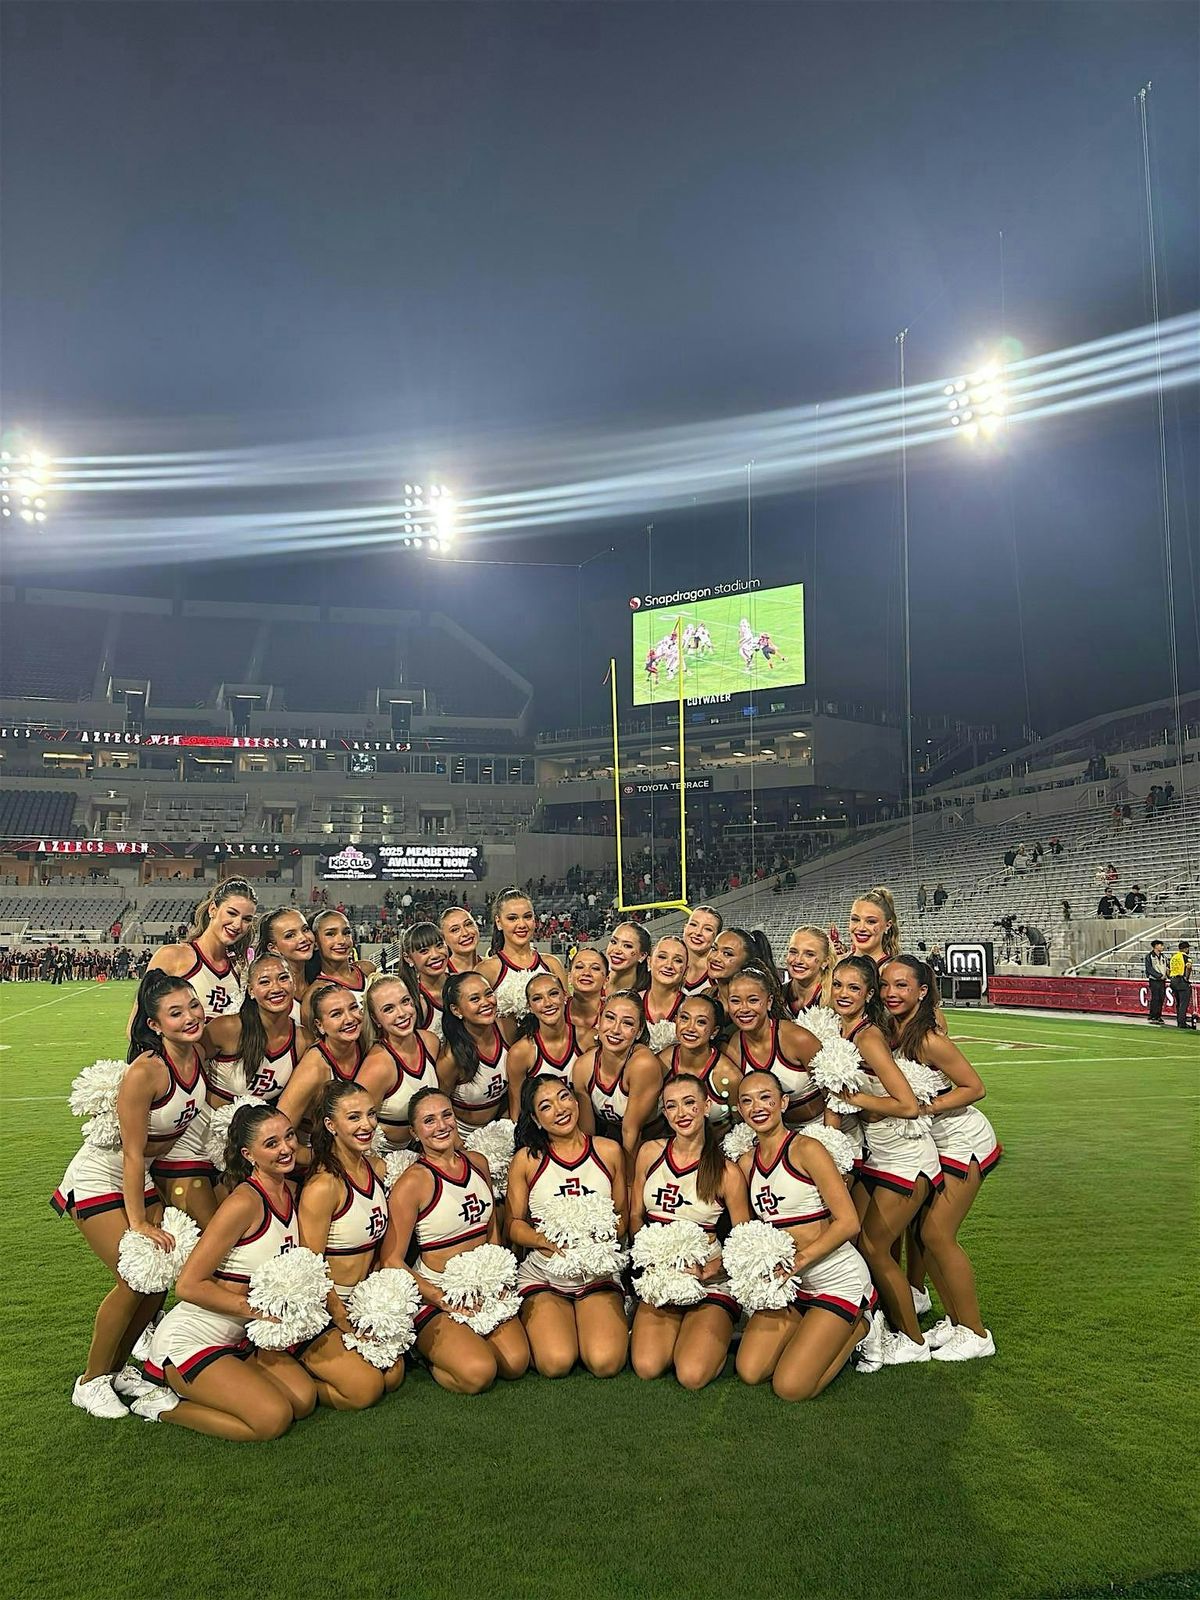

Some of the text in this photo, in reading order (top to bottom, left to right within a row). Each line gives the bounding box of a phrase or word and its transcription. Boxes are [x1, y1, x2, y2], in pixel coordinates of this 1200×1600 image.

[644, 579, 760, 606] Snapdragon stadium
[687, 694, 731, 706] CUTWATER
[81, 731, 180, 745] AZTECS WIN
[232, 738, 327, 749] AZTECS WIN
[637, 784, 669, 793] TOYOTA
[38, 840, 149, 853] AZTECS WIN
[379, 846, 478, 857] 2025 MEMBERSHIPS
[387, 857, 469, 867] AVAILABLE NOW
